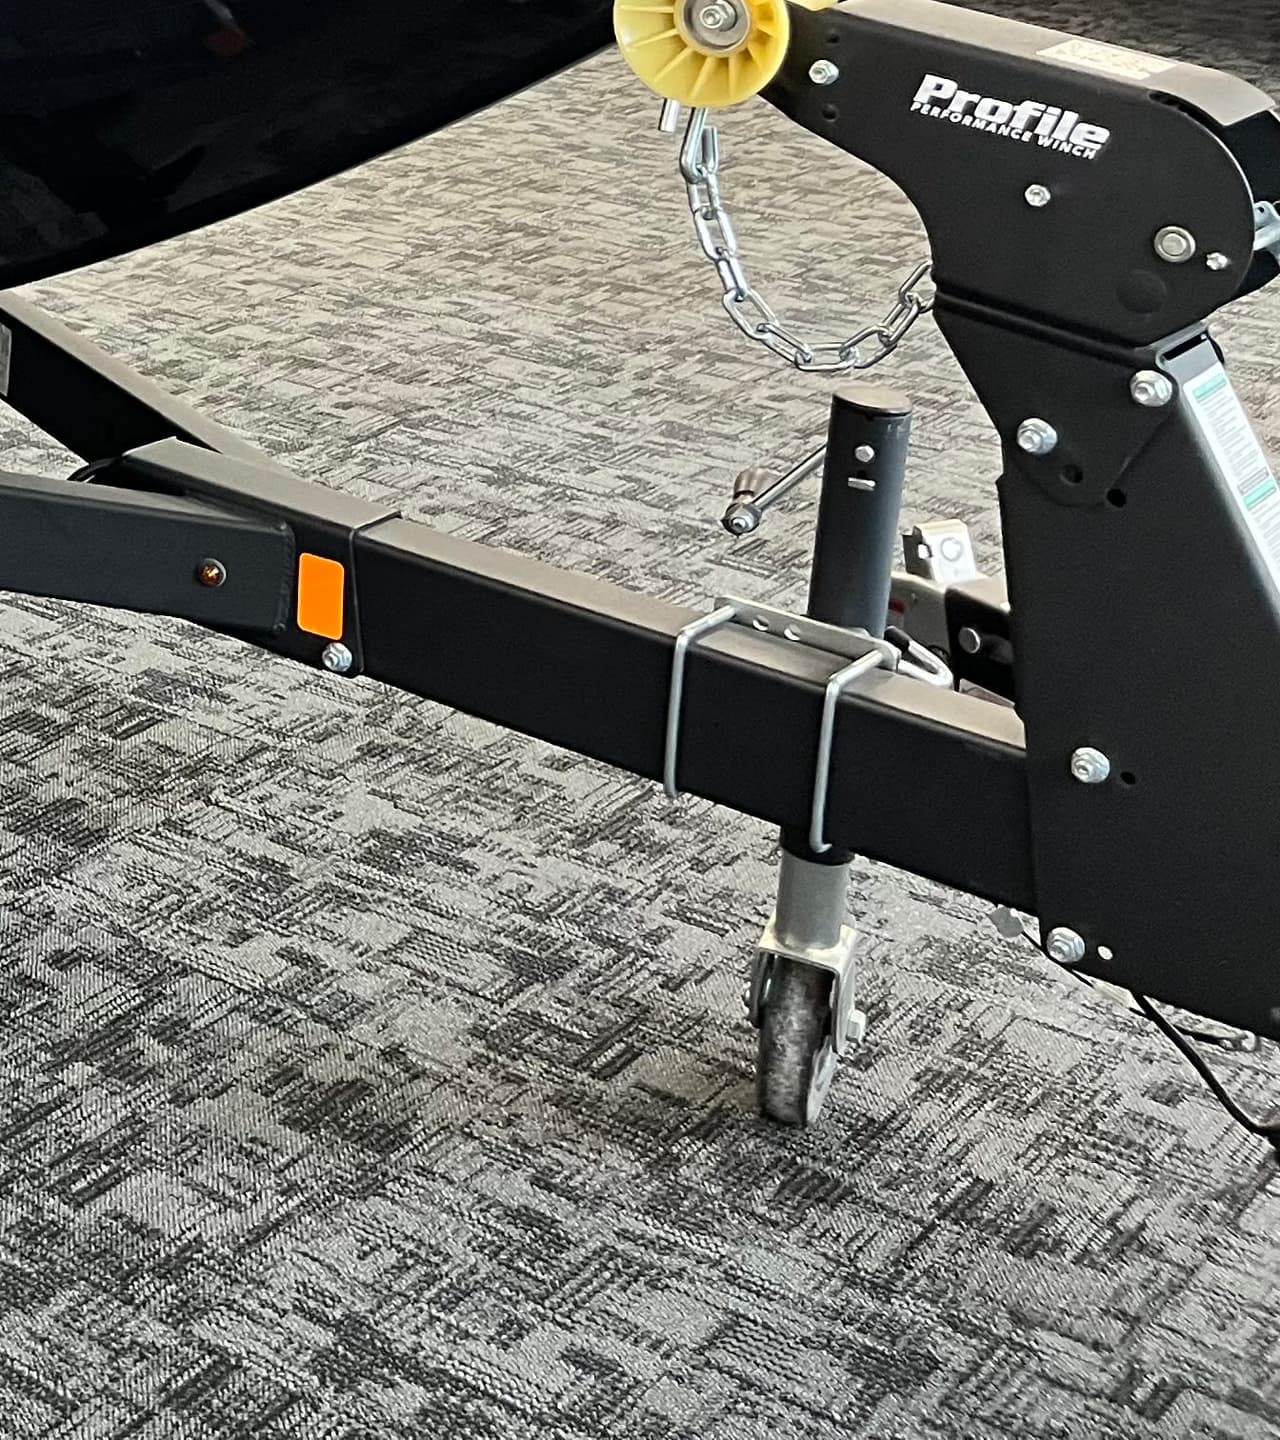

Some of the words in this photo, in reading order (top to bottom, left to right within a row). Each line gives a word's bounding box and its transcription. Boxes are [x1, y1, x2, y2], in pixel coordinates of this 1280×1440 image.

[910, 101, 1034, 142] PERFORMANCE
[1039, 135, 1097, 160] WINCH
[912, 73, 1111, 151] Profile
